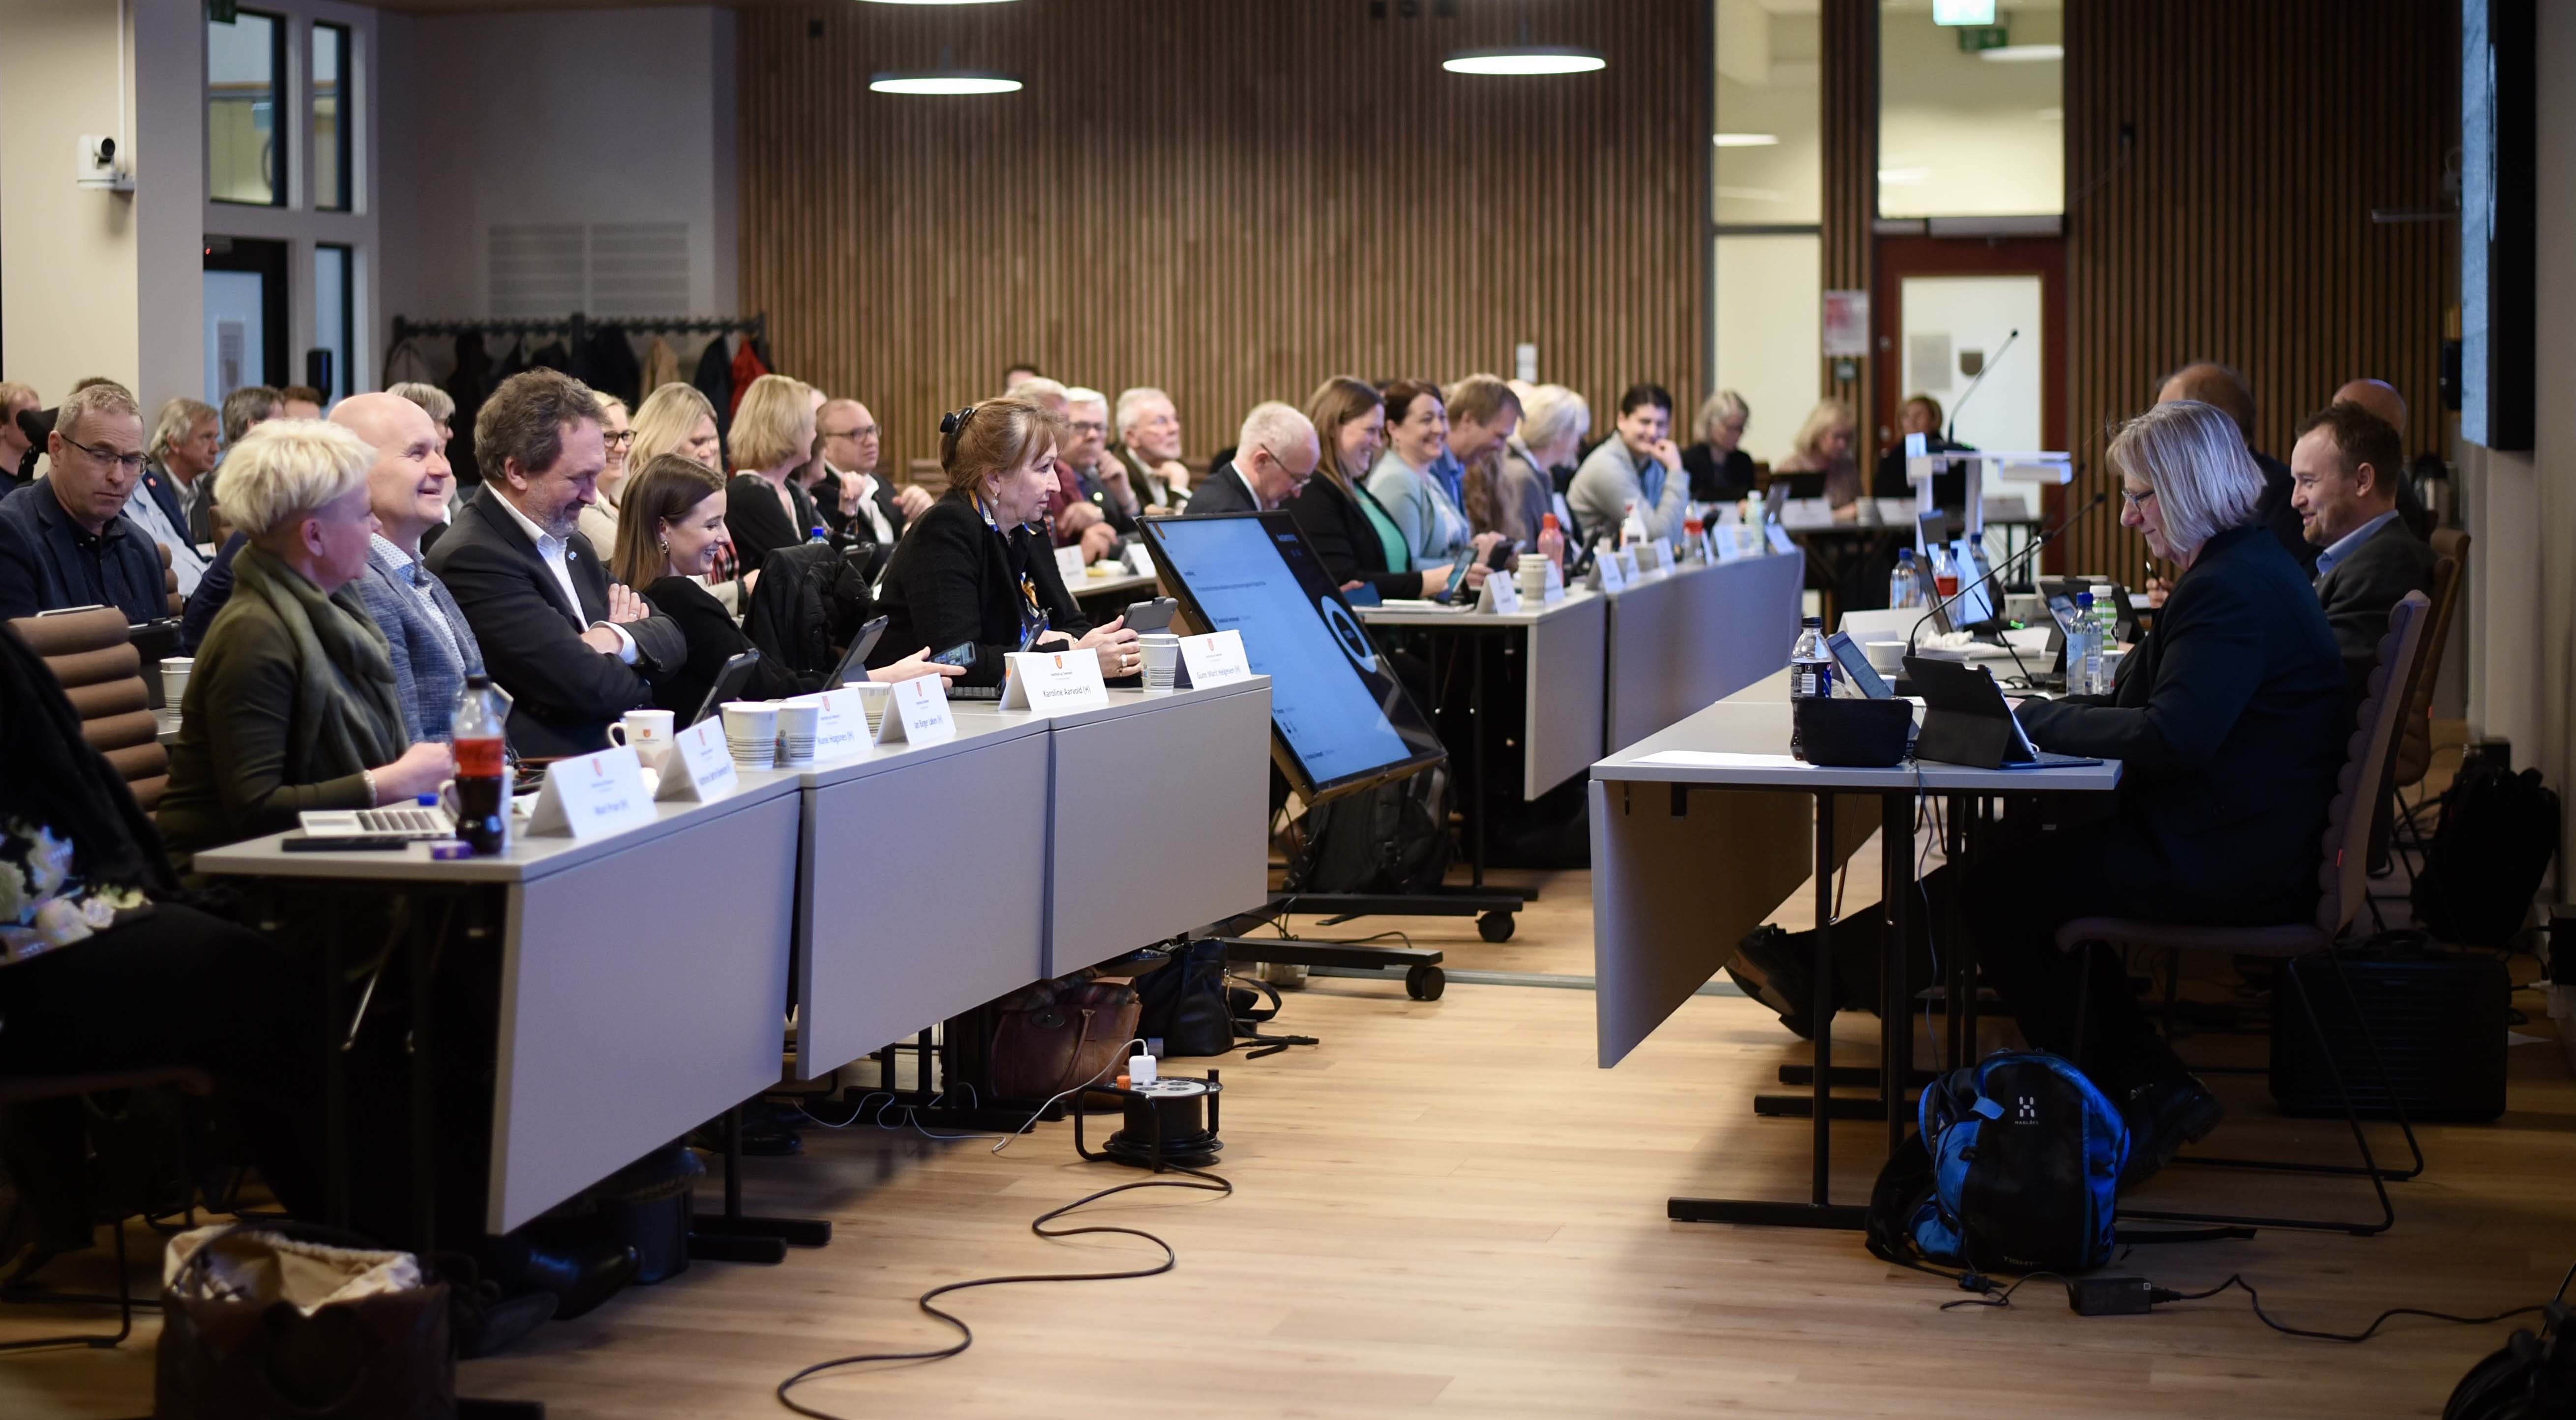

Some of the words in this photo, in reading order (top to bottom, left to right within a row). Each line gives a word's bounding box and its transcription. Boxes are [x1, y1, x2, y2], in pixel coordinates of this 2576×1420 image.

[1043, 688, 1064, 697] Karoline
[1064, 686, 1083, 695] Aarvold
[1083, 684, 1091, 695] (H)
[2002, 1254, 2035, 1268] TIGHT
